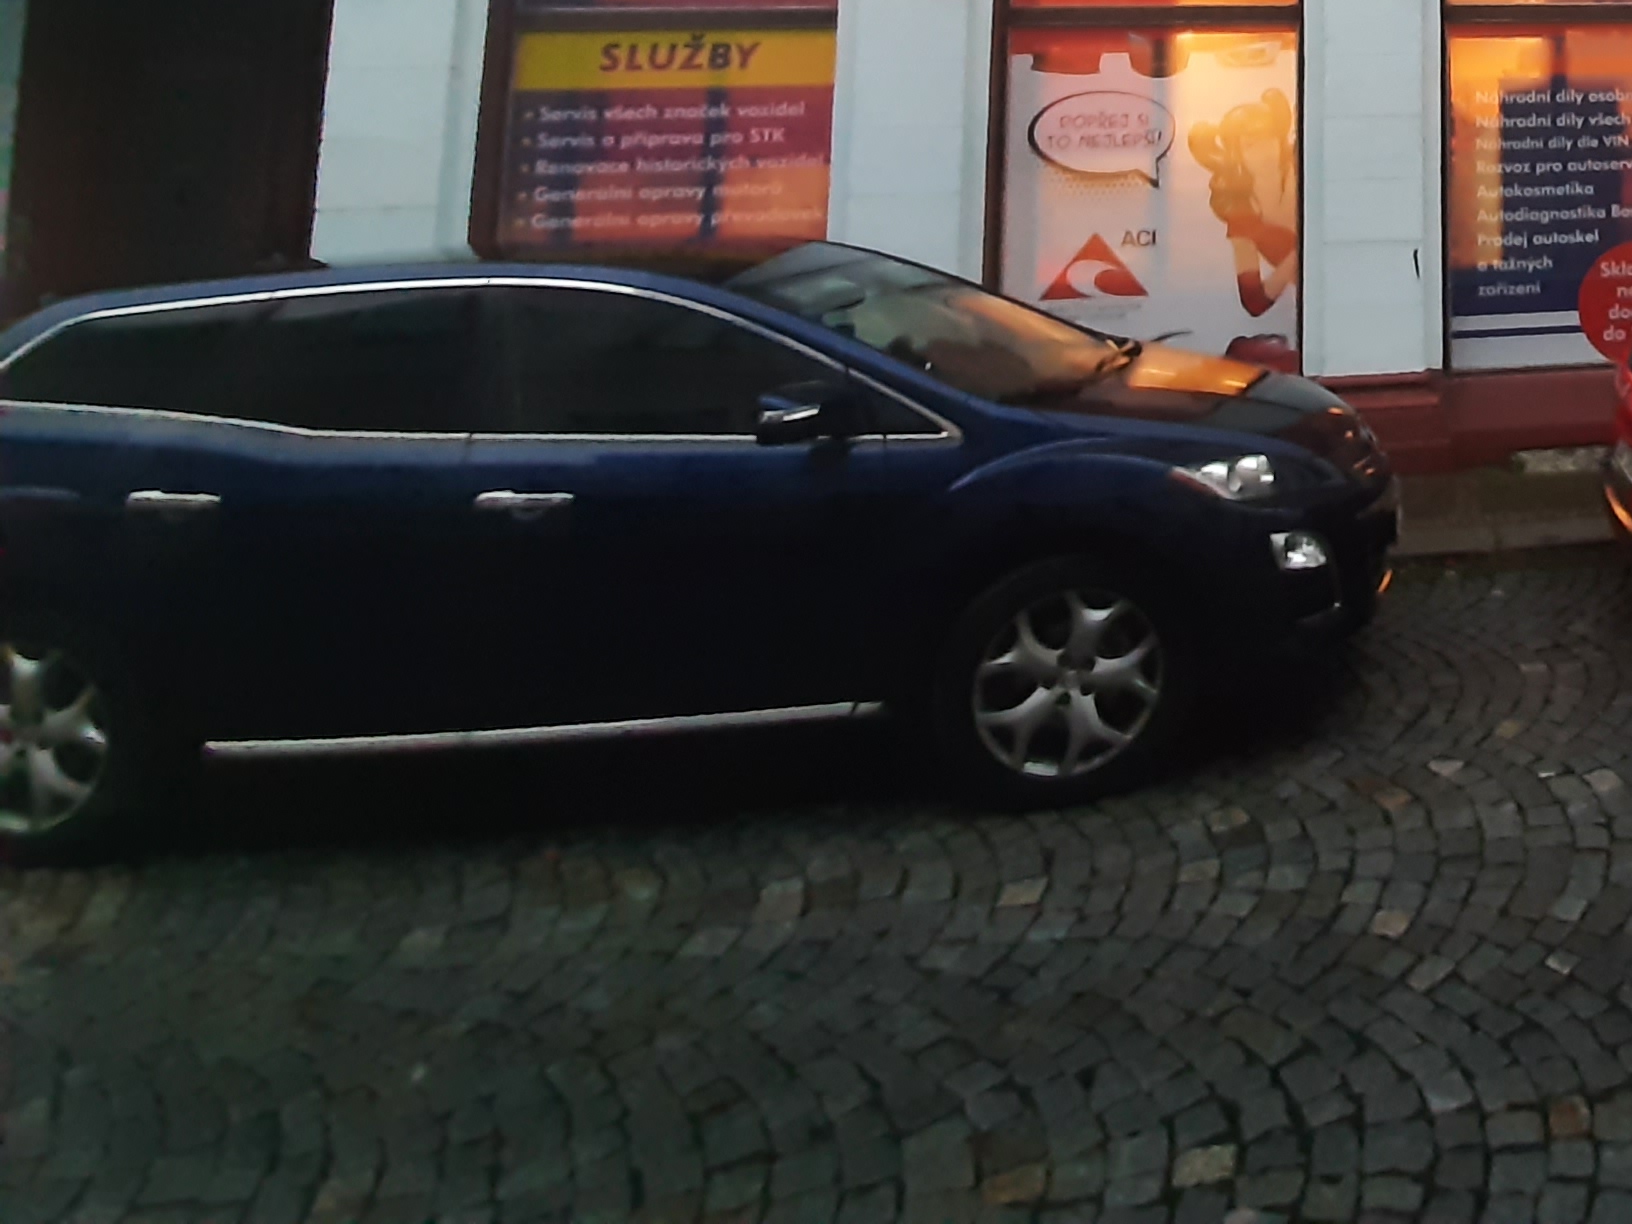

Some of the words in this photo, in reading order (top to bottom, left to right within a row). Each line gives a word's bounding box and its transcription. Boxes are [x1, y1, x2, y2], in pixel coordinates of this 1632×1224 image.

[600, 32, 761, 72] SLUŽBY
[540, 105, 597, 121] Servis
[736, 101, 806, 117] vozidel
[537, 132, 595, 148] Servis
[602, 135, 615, 146] a
[709, 133, 743, 147] pro
[750, 127, 785, 143] STK
[1047, 134, 1071, 149] TO
[1602, 134, 1629, 147] VIN
[1476, 160, 1531, 174] Rozvoz
[1535, 162, 1562, 176] pro
[639, 185, 705, 201] opravy
[1477, 181, 1595, 198] Autokosmetika
[1477, 204, 1606, 224] Autodiagnostika
[1121, 229, 1157, 247] ACI
[1477, 232, 1527, 249] Prodej
[1532, 228, 1600, 245] autoskel
[1477, 260, 1487, 272] a
[1603, 325, 1626, 341] do
